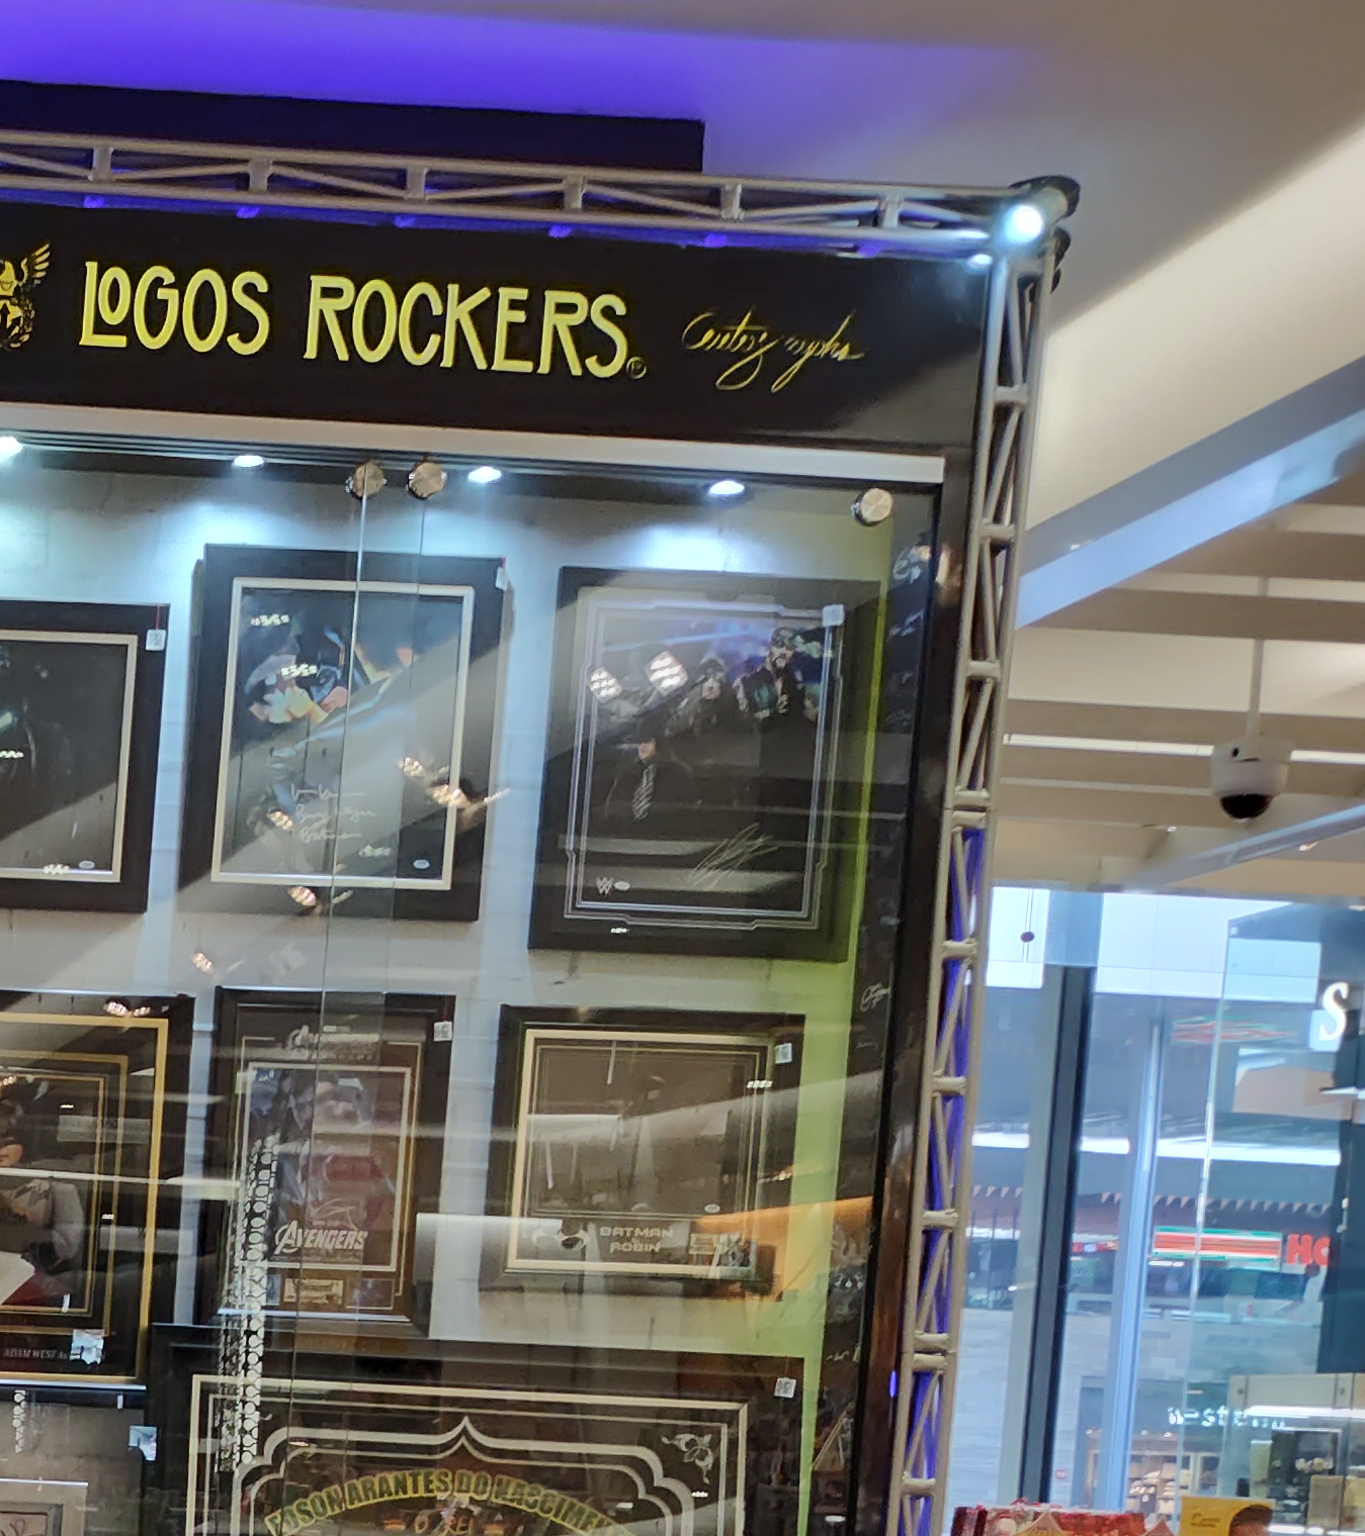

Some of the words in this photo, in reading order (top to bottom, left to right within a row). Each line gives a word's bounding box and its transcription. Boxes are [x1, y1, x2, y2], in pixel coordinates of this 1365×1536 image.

[79, 260, 269, 357] LOGOS
[303, 273, 628, 379] ROCKERS
[599, 1226, 674, 1239] BATMAN
[344, 1468, 453, 1509] ARANTES
[452, 1469, 492, 1500] DO
